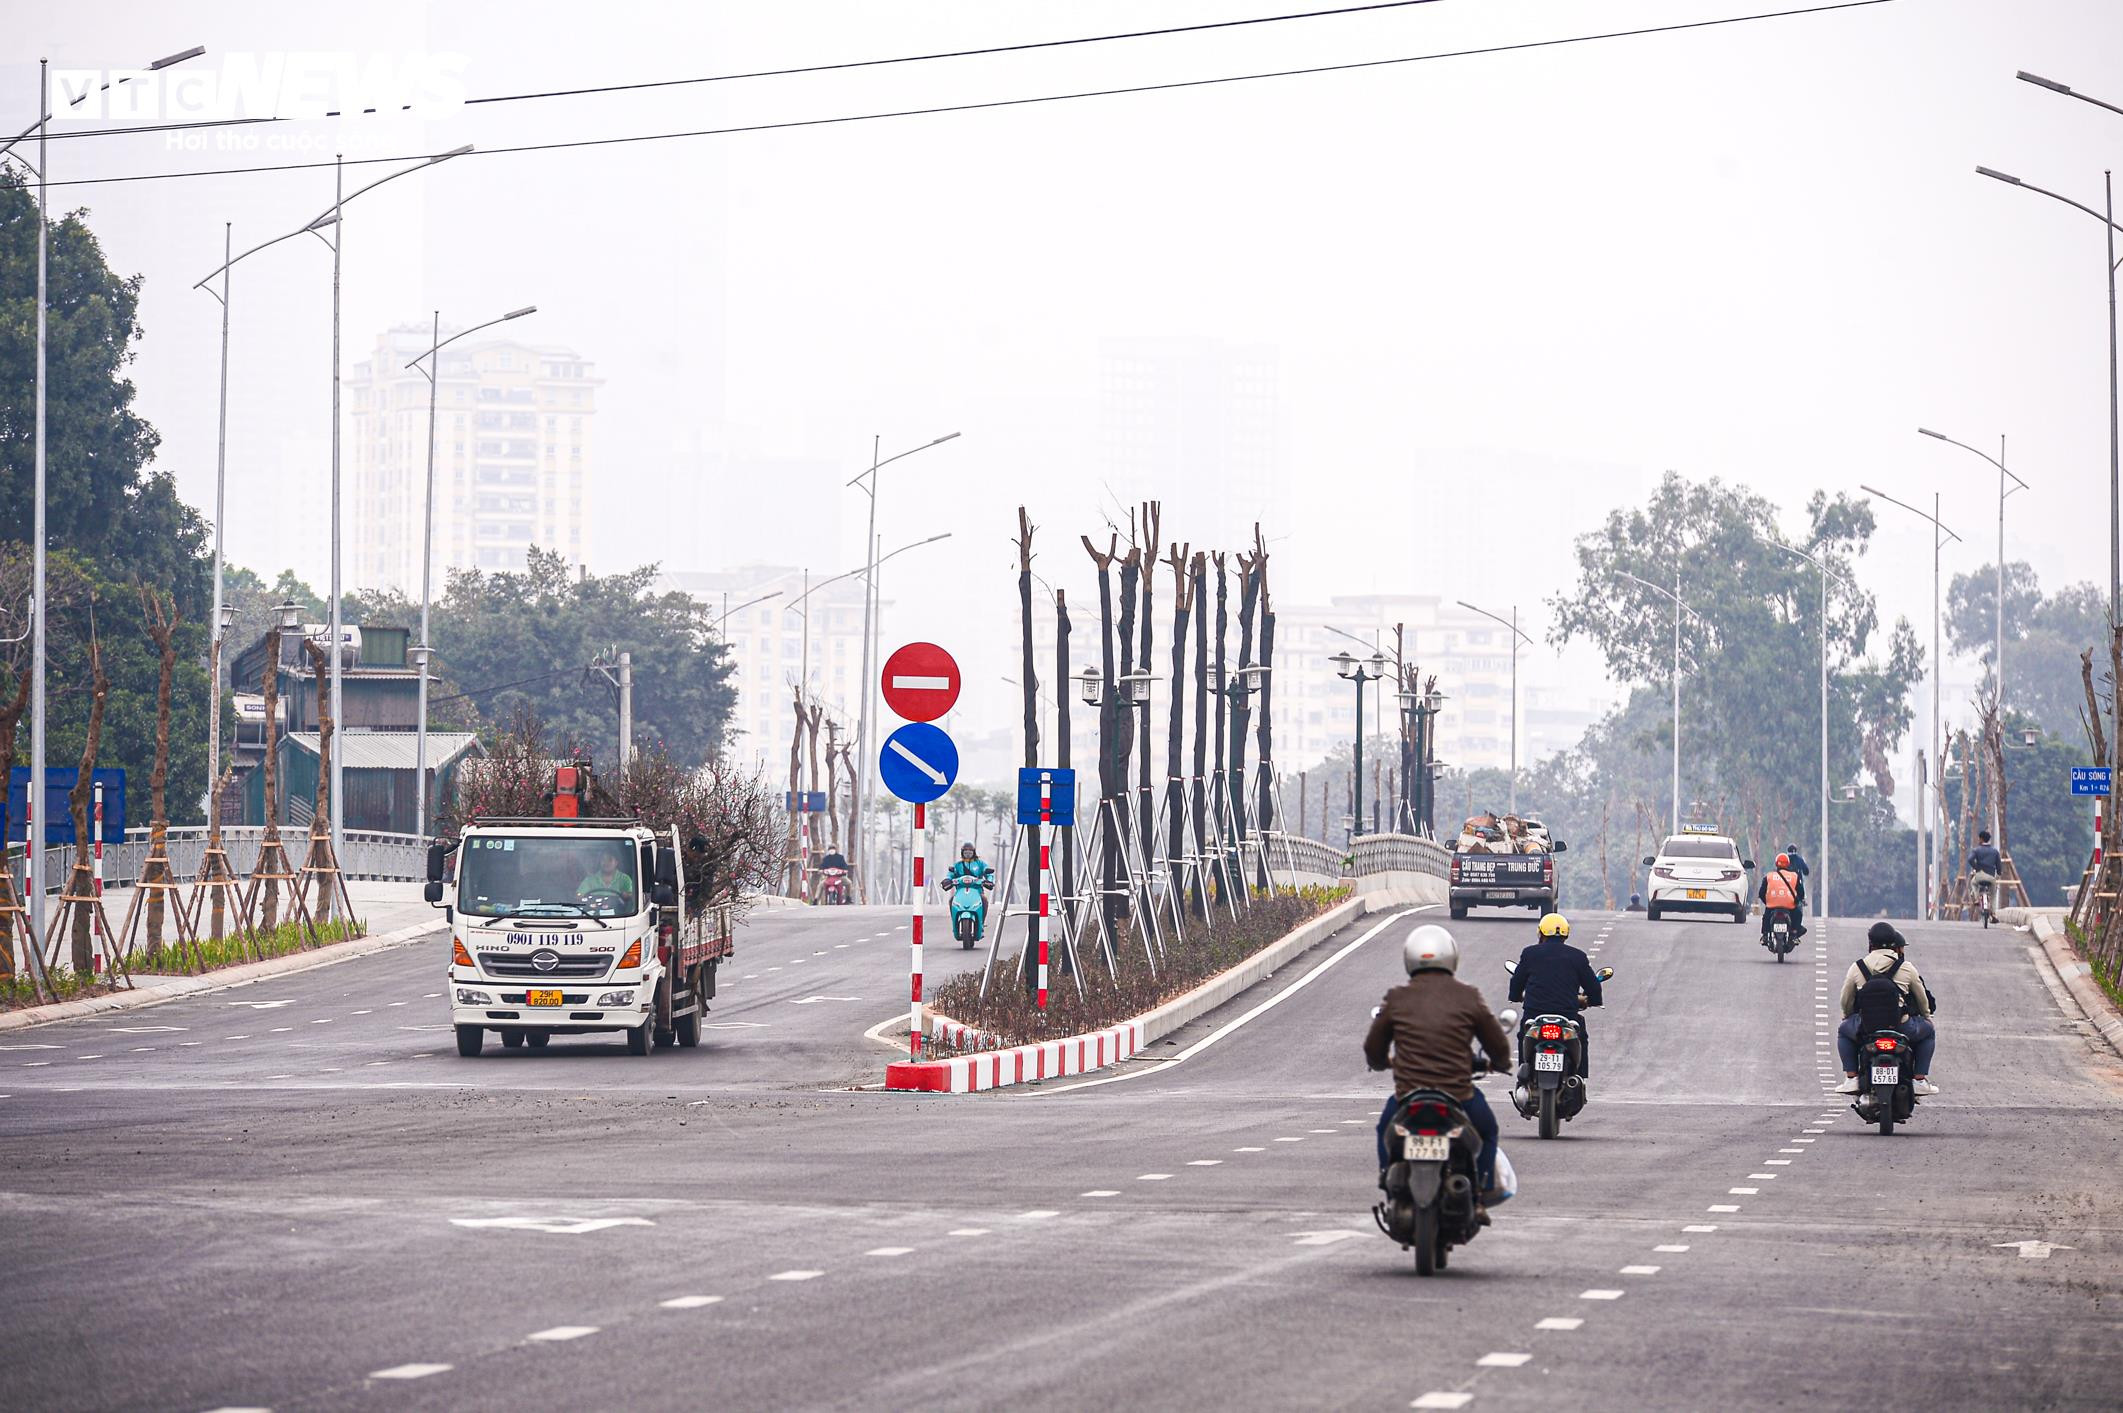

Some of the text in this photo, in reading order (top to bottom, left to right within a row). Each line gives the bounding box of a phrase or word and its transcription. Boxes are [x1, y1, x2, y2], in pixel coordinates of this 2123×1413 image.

[1508, 862, 1526, 872] TRUNG
[1528, 860, 1540, 872] ĐỨC
[506, 932, 584, 946] 0901 119 119
